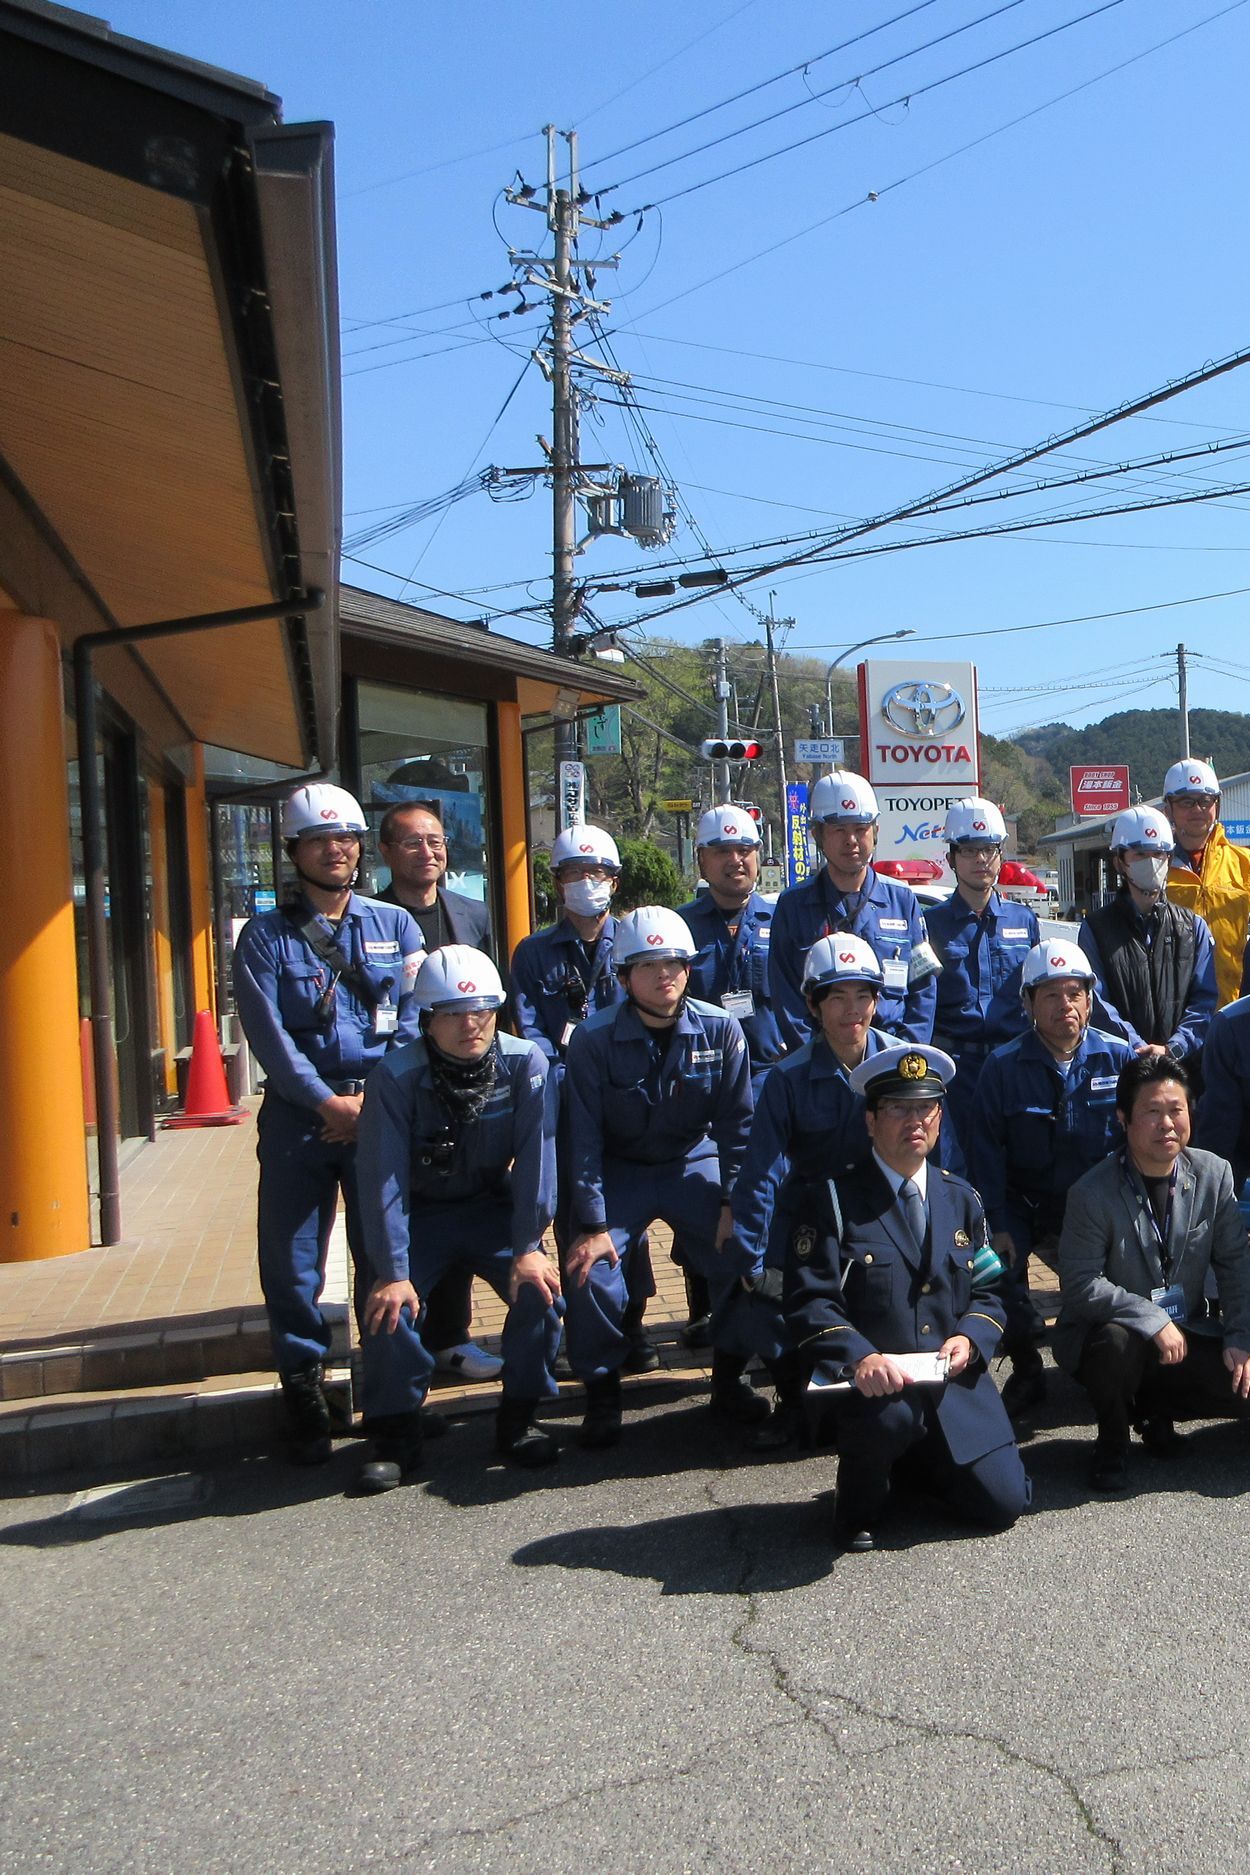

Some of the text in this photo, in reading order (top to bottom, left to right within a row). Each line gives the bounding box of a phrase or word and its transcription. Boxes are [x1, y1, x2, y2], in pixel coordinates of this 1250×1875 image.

[799, 743, 839, 753] 矢走口北
[876, 745, 971, 764] TOYOTA
